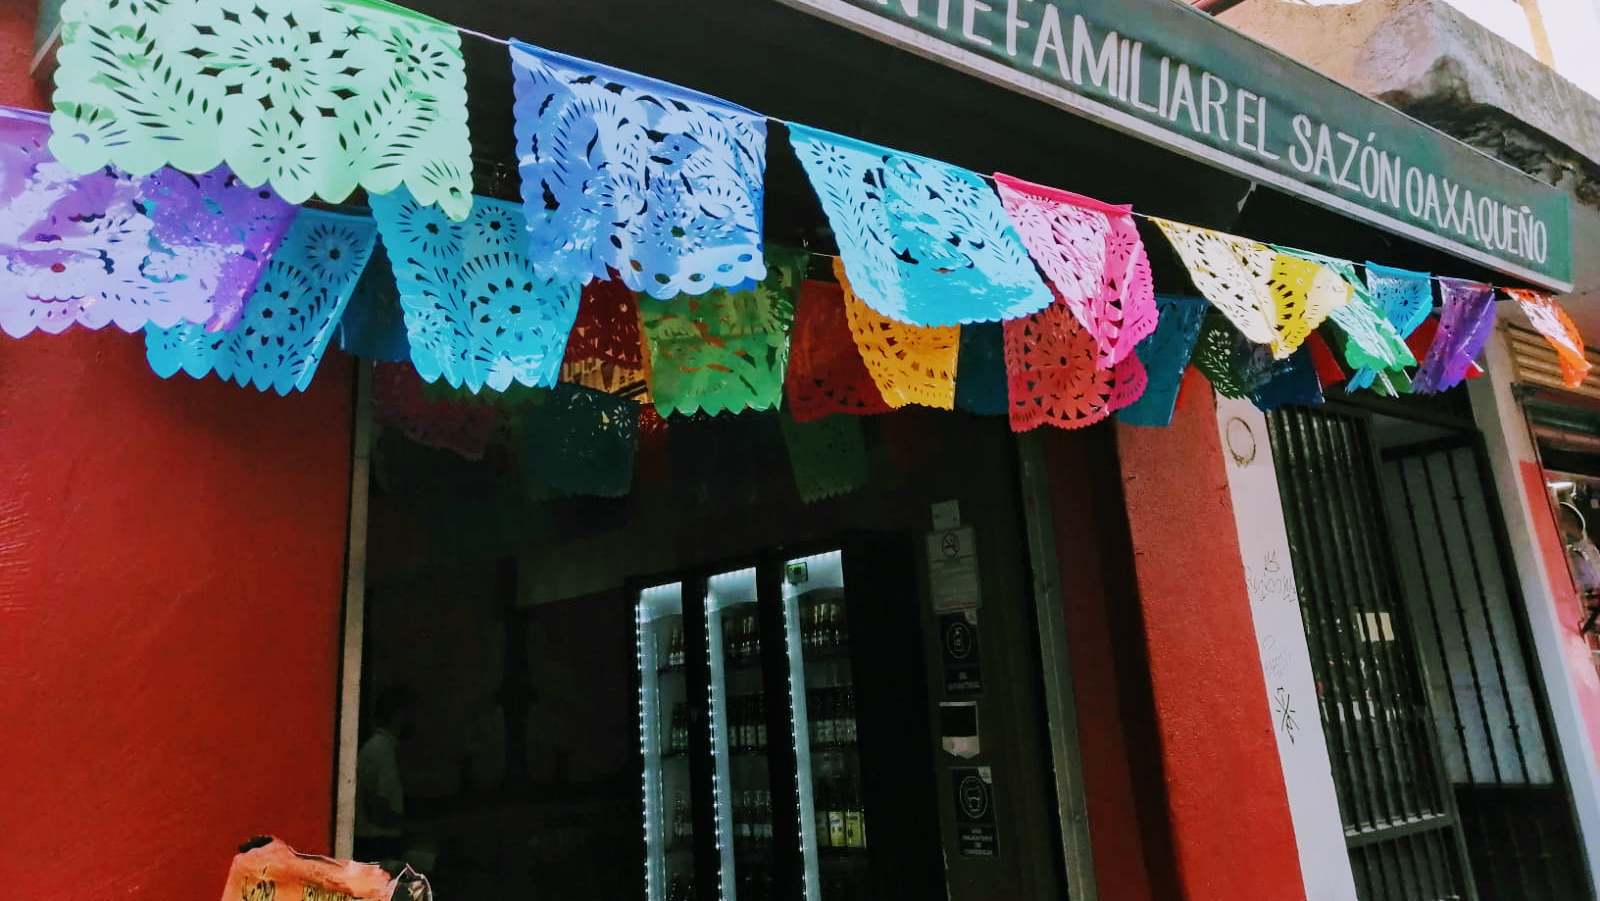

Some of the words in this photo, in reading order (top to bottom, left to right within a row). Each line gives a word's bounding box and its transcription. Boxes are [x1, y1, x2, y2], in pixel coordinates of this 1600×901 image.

[1006, 0, 1229, 141] FAMILIAR
[1236, 88, 1280, 160] EL
[1288, 114, 1401, 208] SAZÓN
[1405, 166, 1548, 264] OAXAQUEÑO
